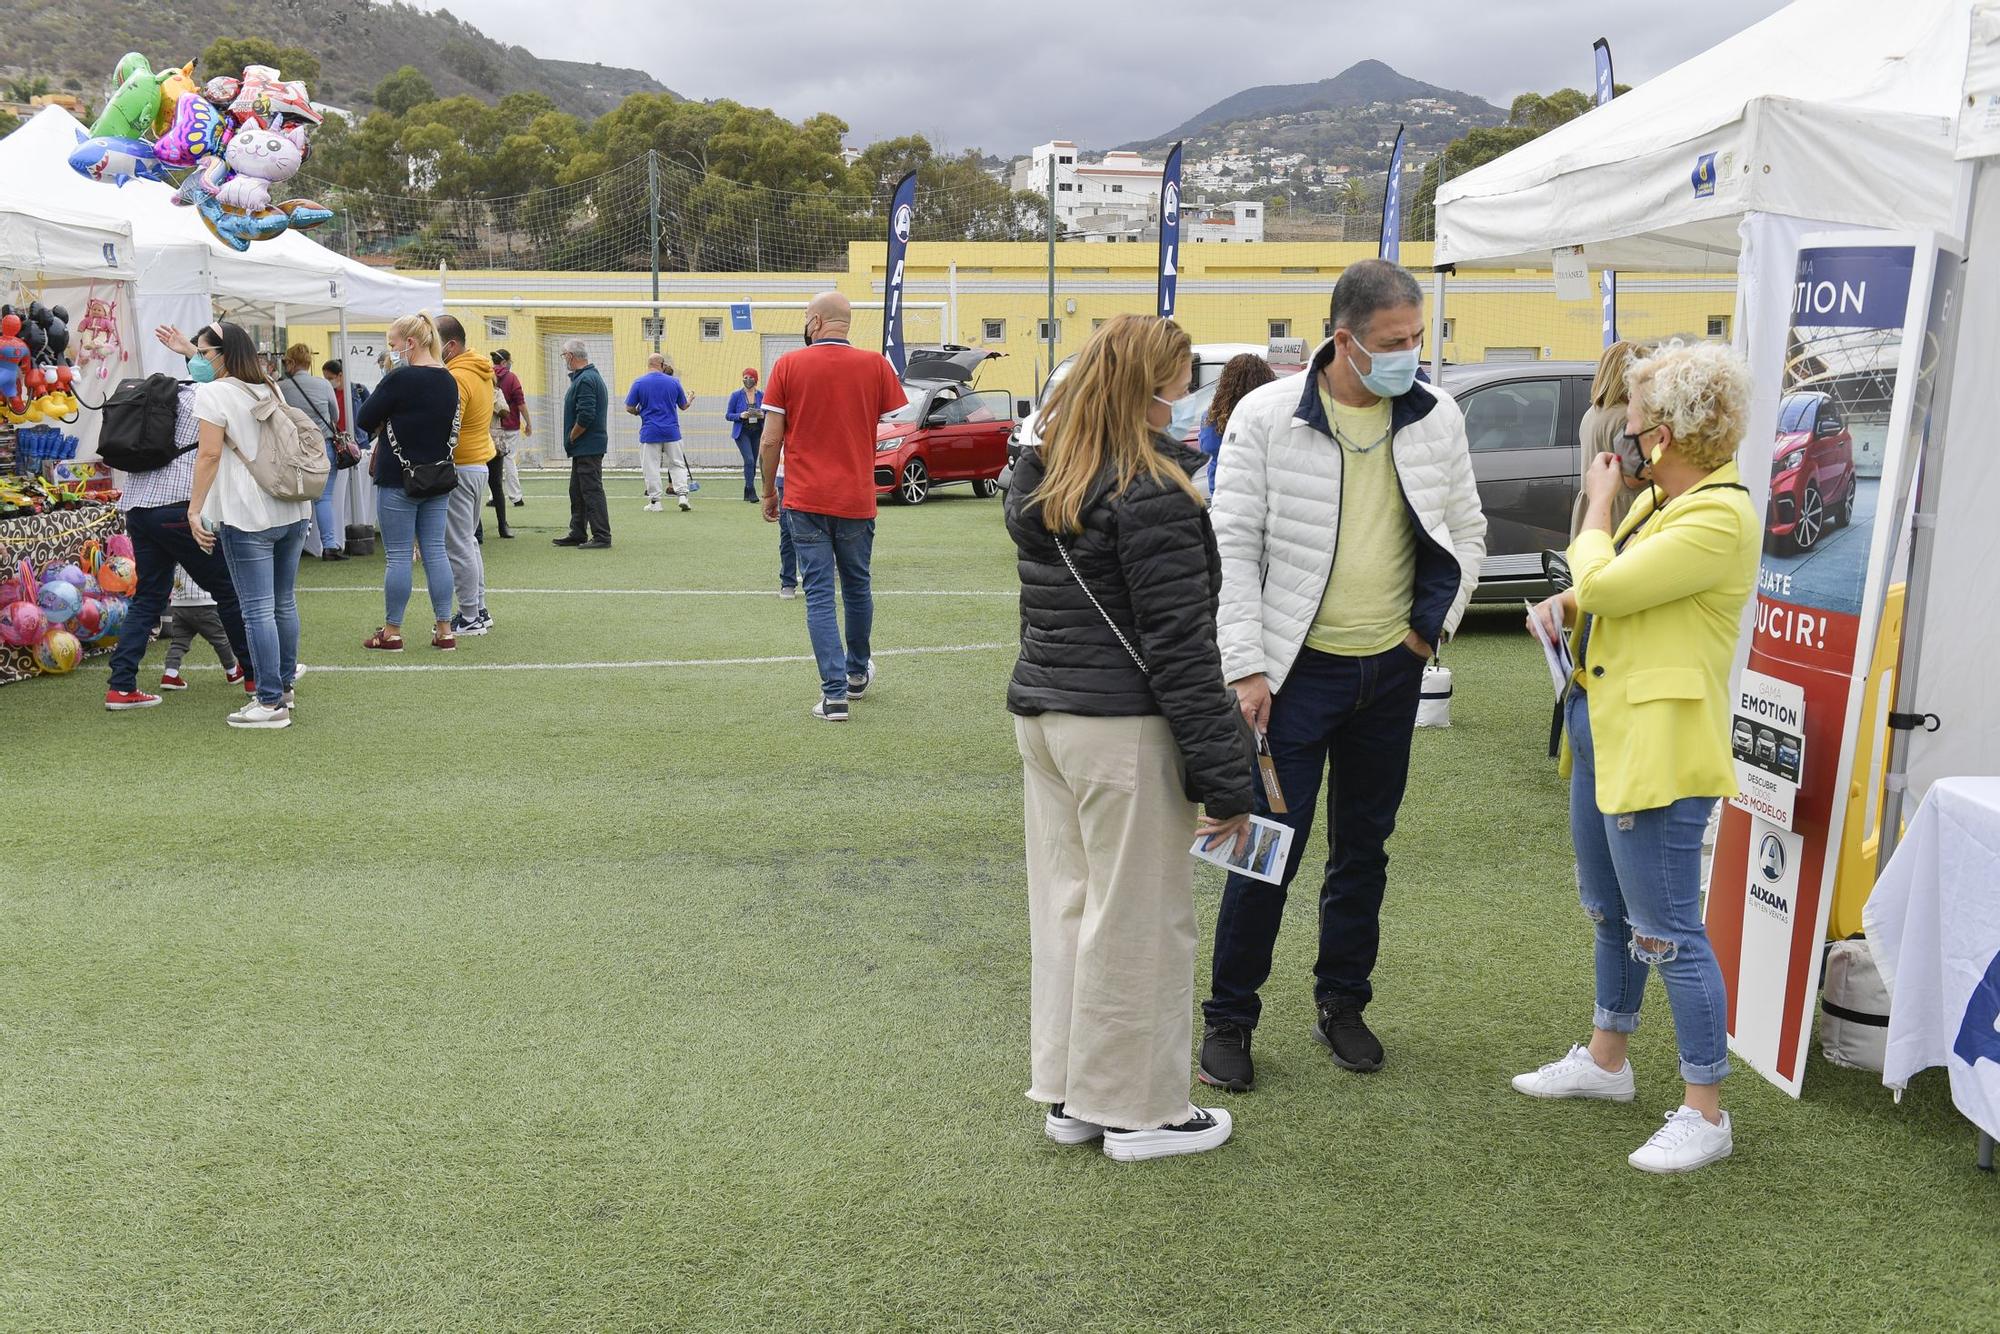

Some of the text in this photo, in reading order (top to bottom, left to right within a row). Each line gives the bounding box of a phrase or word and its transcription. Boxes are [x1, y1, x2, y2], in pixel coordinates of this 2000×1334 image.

[350, 345, 374, 357] A-2
[1759, 682, 1782, 698] GAMA
[1741, 692, 1797, 727] EMOTION
[1747, 772, 1777, 793] DESCUBRE
[1749, 797, 1788, 823] MODELOS
[1750, 883, 1789, 914] AIXAM
[1768, 908, 1789, 925] VENTAS
